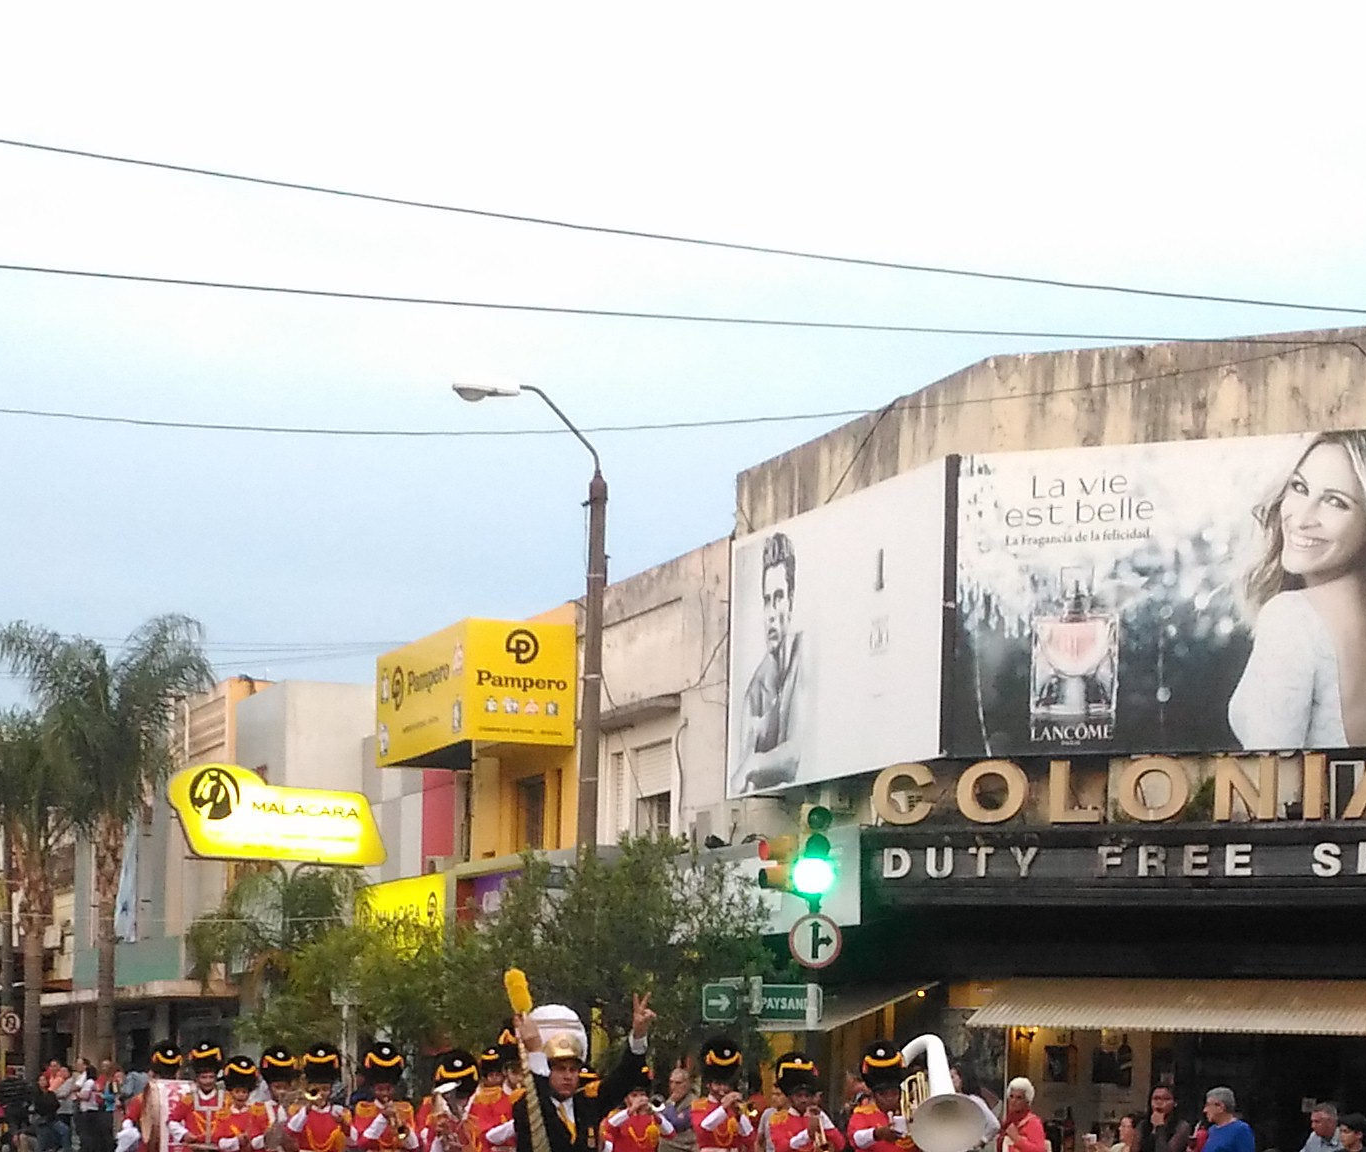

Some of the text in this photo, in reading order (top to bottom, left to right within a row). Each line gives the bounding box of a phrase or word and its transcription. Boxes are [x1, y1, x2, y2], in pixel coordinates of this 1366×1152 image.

[1032, 470, 1128, 499] La vie
[1005, 497, 1154, 528] est belle
[1005, 535, 1018, 546] La
[1022, 532, 1073, 547] Fragancia
[1075, 529, 1088, 543] de
[1090, 529, 1100, 542] la
[407, 663, 451, 696] Pampero
[476, 669, 567, 692] Pampero
[1030, 722, 1114, 741] LANCÔME
[253, 801, 360, 819] MALACARA
[883, 846, 1039, 879] DUTY
[1097, 844, 1253, 879] FREE
[761, 997, 808, 1010] PAYSAN
